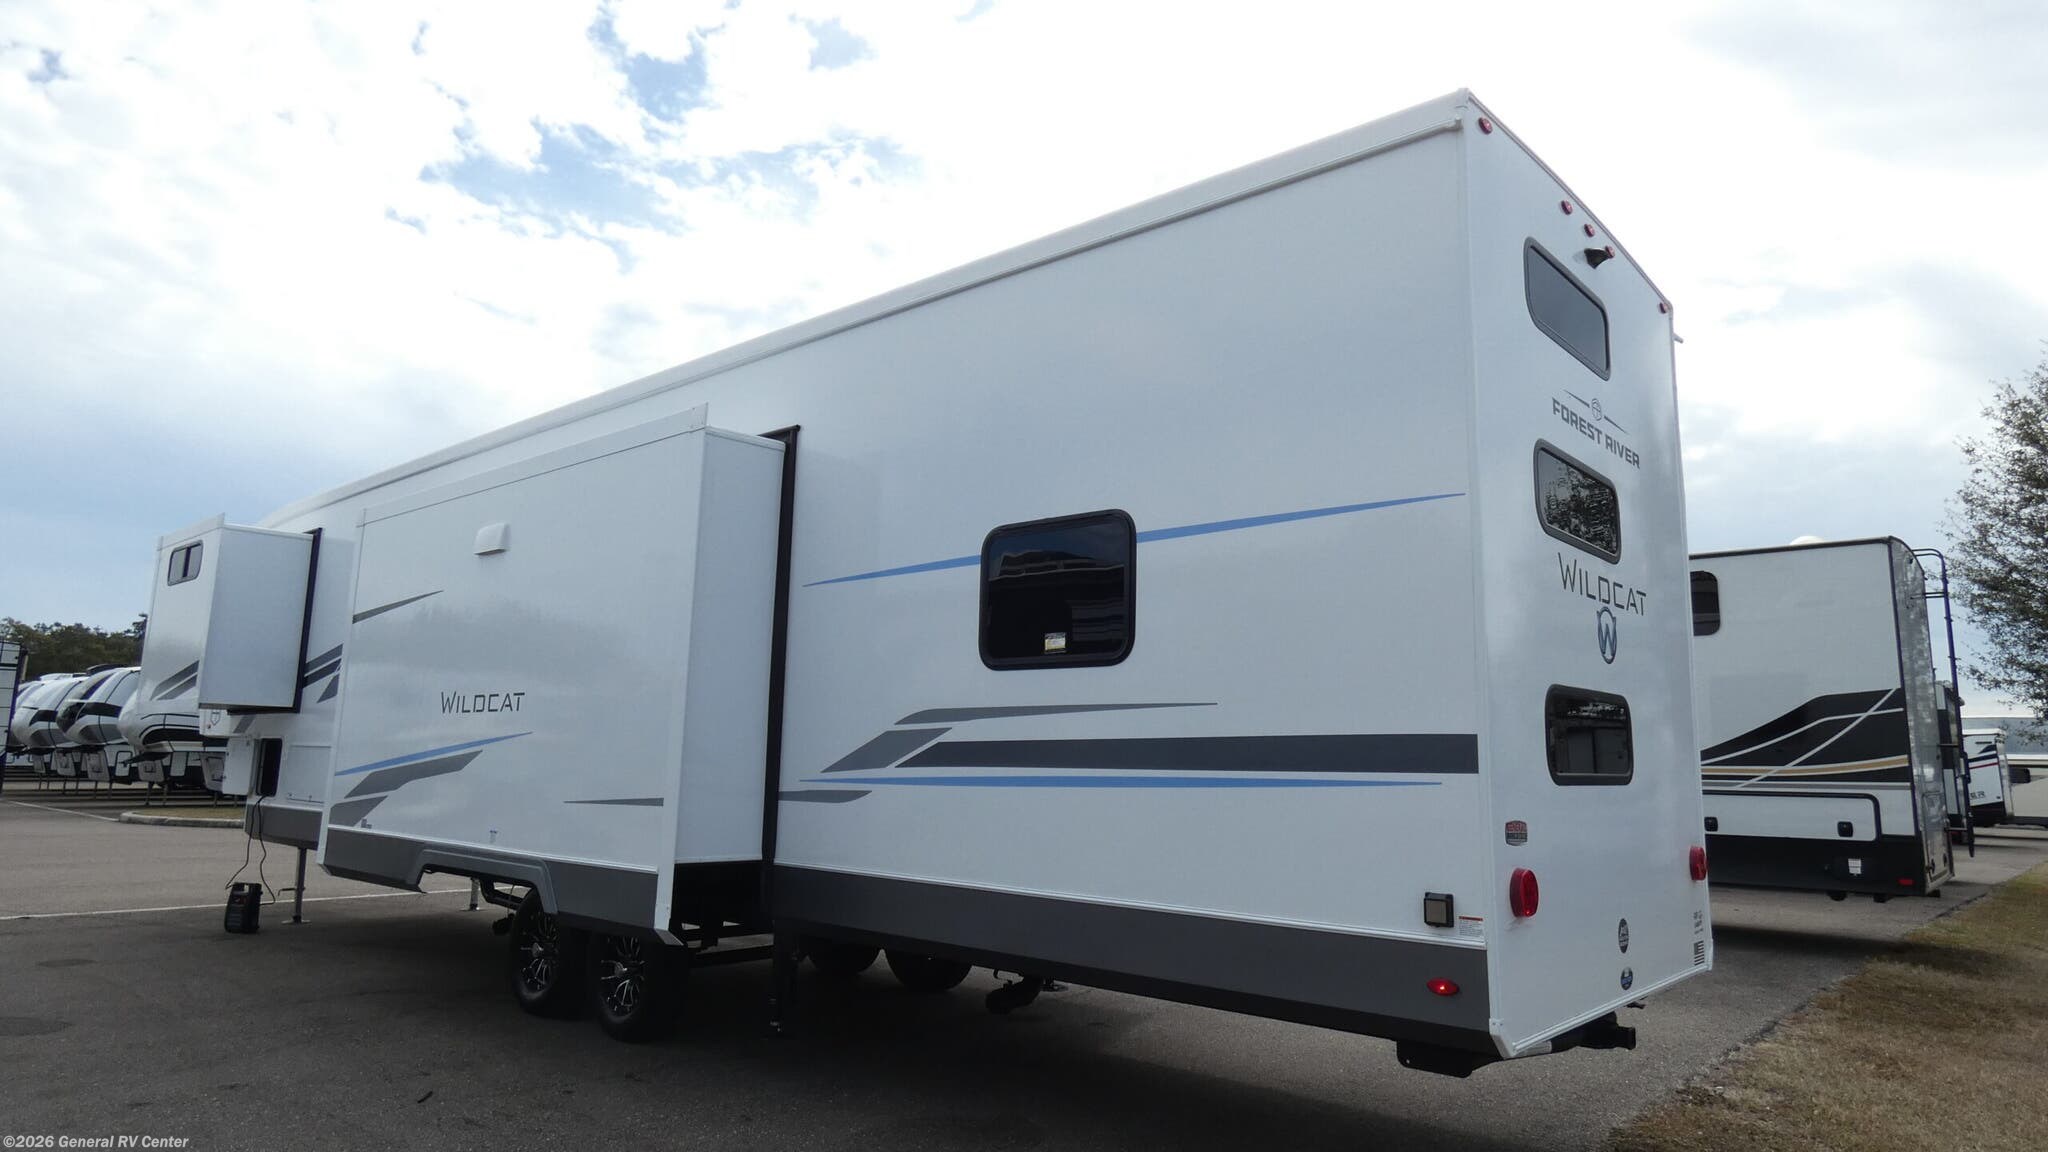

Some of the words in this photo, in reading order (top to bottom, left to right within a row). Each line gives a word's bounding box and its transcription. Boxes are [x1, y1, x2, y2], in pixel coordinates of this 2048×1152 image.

[1552, 397, 1602, 444] FOREST
[1605, 433, 1640, 470] RIVER
[1558, 552, 1647, 616] WILDCAT
[441, 691, 525, 714] WILDCAT
